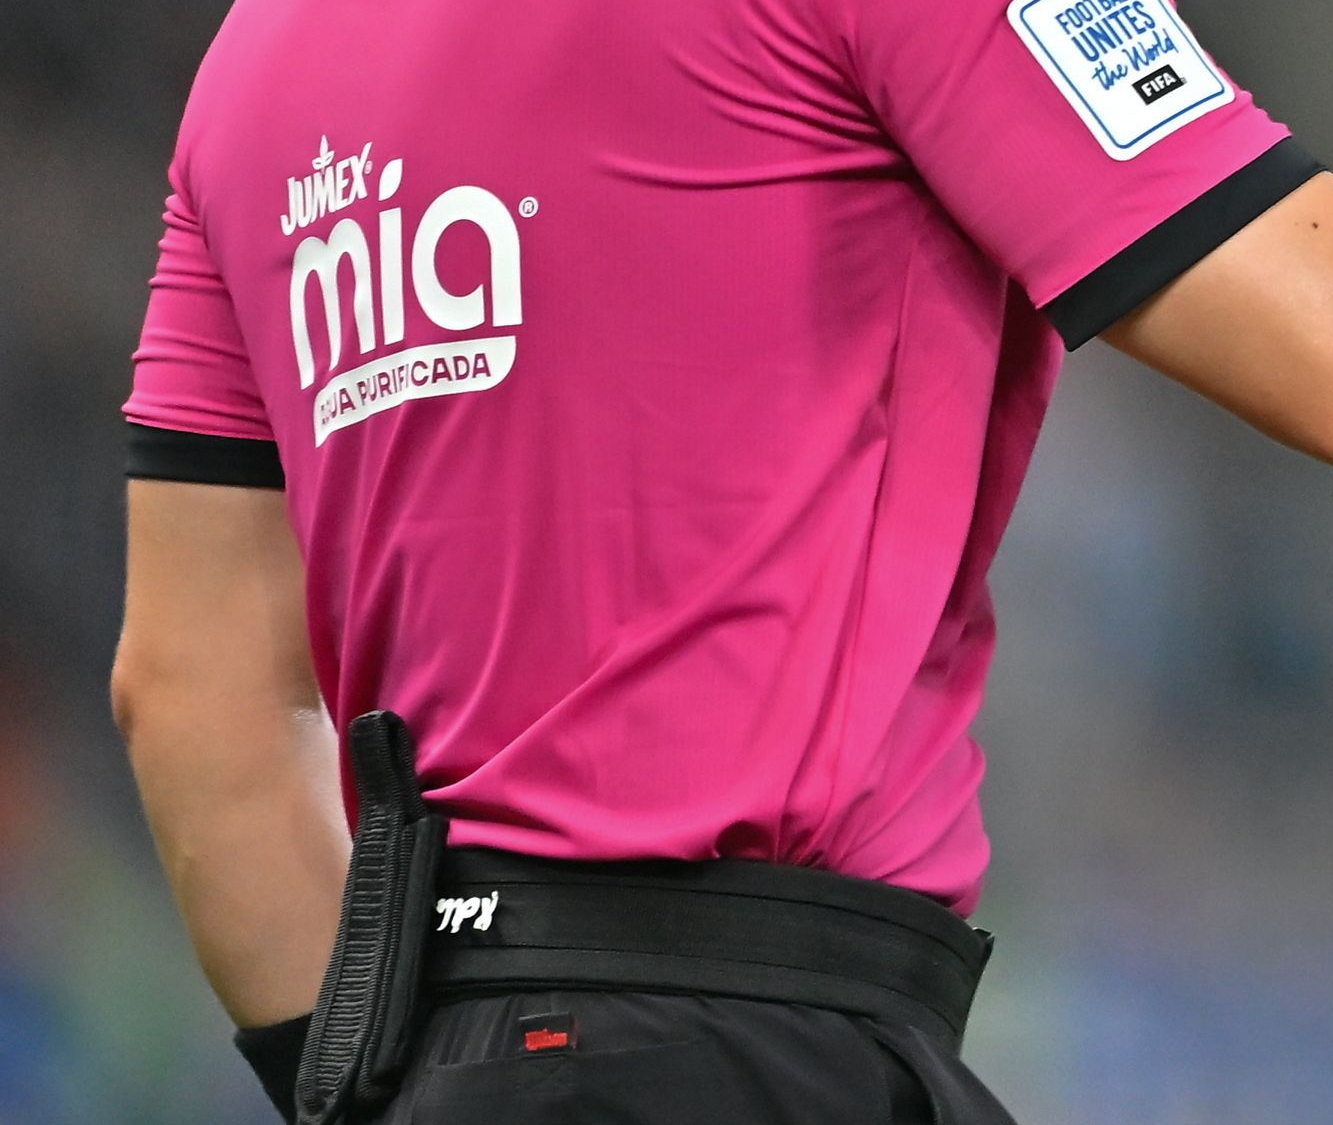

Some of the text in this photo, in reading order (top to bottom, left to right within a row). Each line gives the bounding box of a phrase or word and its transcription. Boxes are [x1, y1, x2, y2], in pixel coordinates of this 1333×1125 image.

[1071, 0, 1156, 62] UNITES
[1091, 28, 1179, 91] the World
[1141, 72, 1177, 97] FIFA
[280, 141, 372, 236] JUMEX
[290, 158, 523, 390] mia
